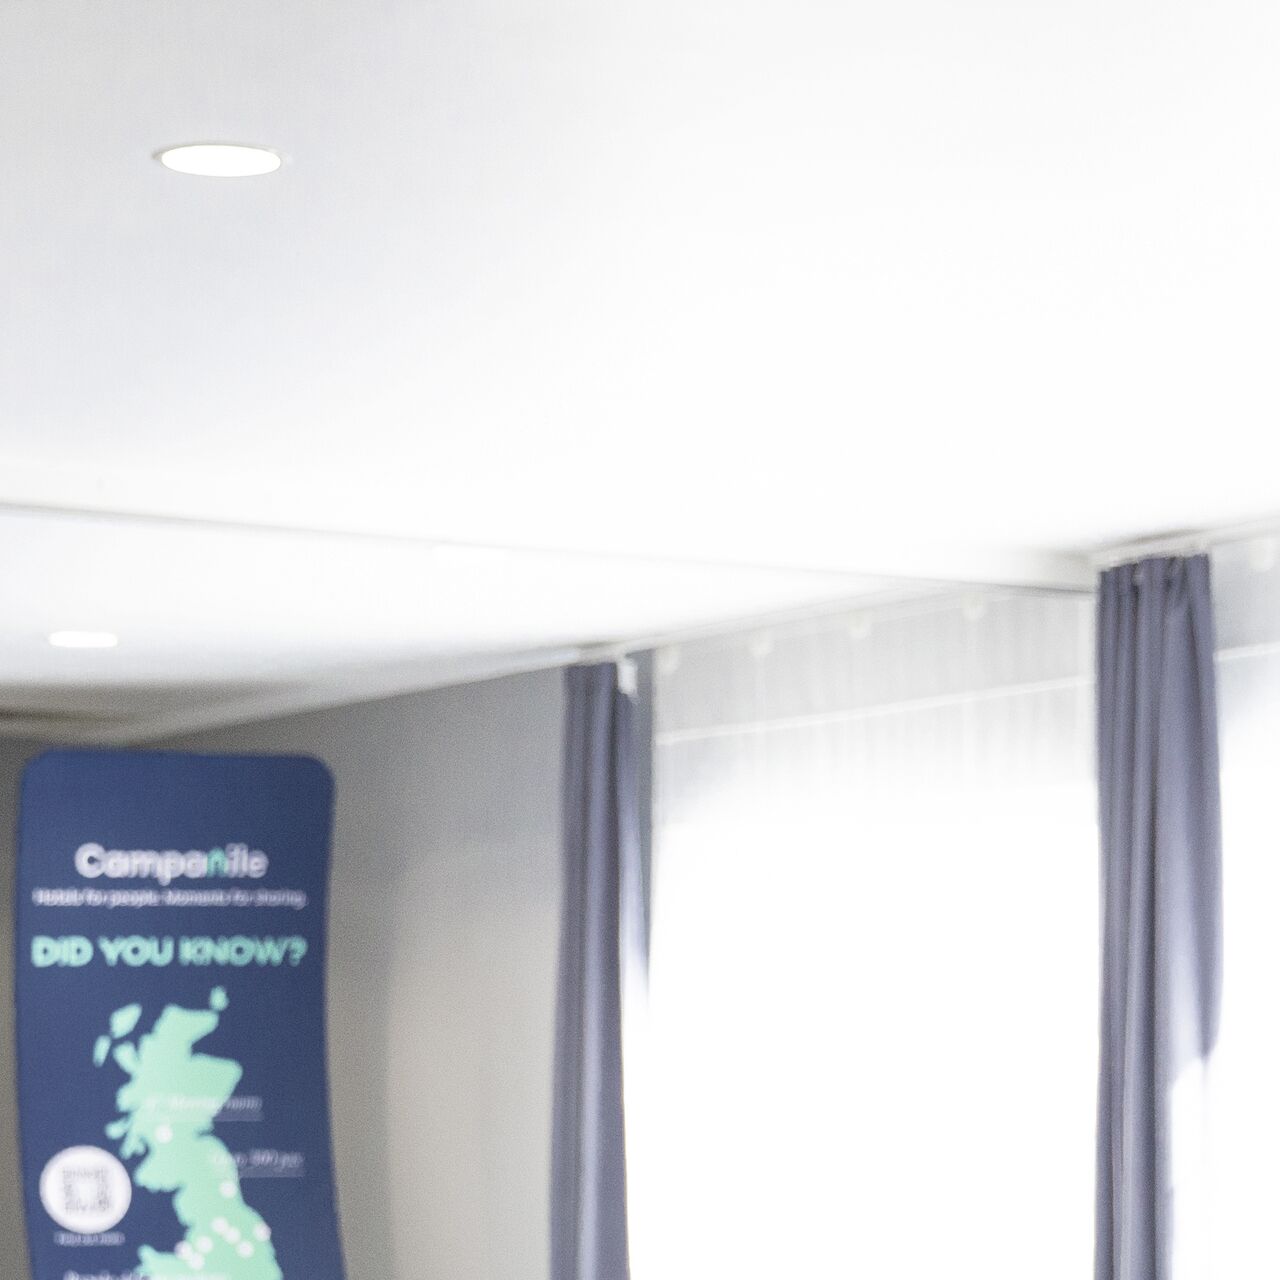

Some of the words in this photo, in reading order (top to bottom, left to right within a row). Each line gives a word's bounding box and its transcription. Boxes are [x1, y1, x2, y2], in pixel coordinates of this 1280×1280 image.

[74, 842, 269, 886] Campanile
[31, 935, 94, 968] DID
[96, 935, 175, 968] YOU
[177, 935, 308, 968] KNOW?
